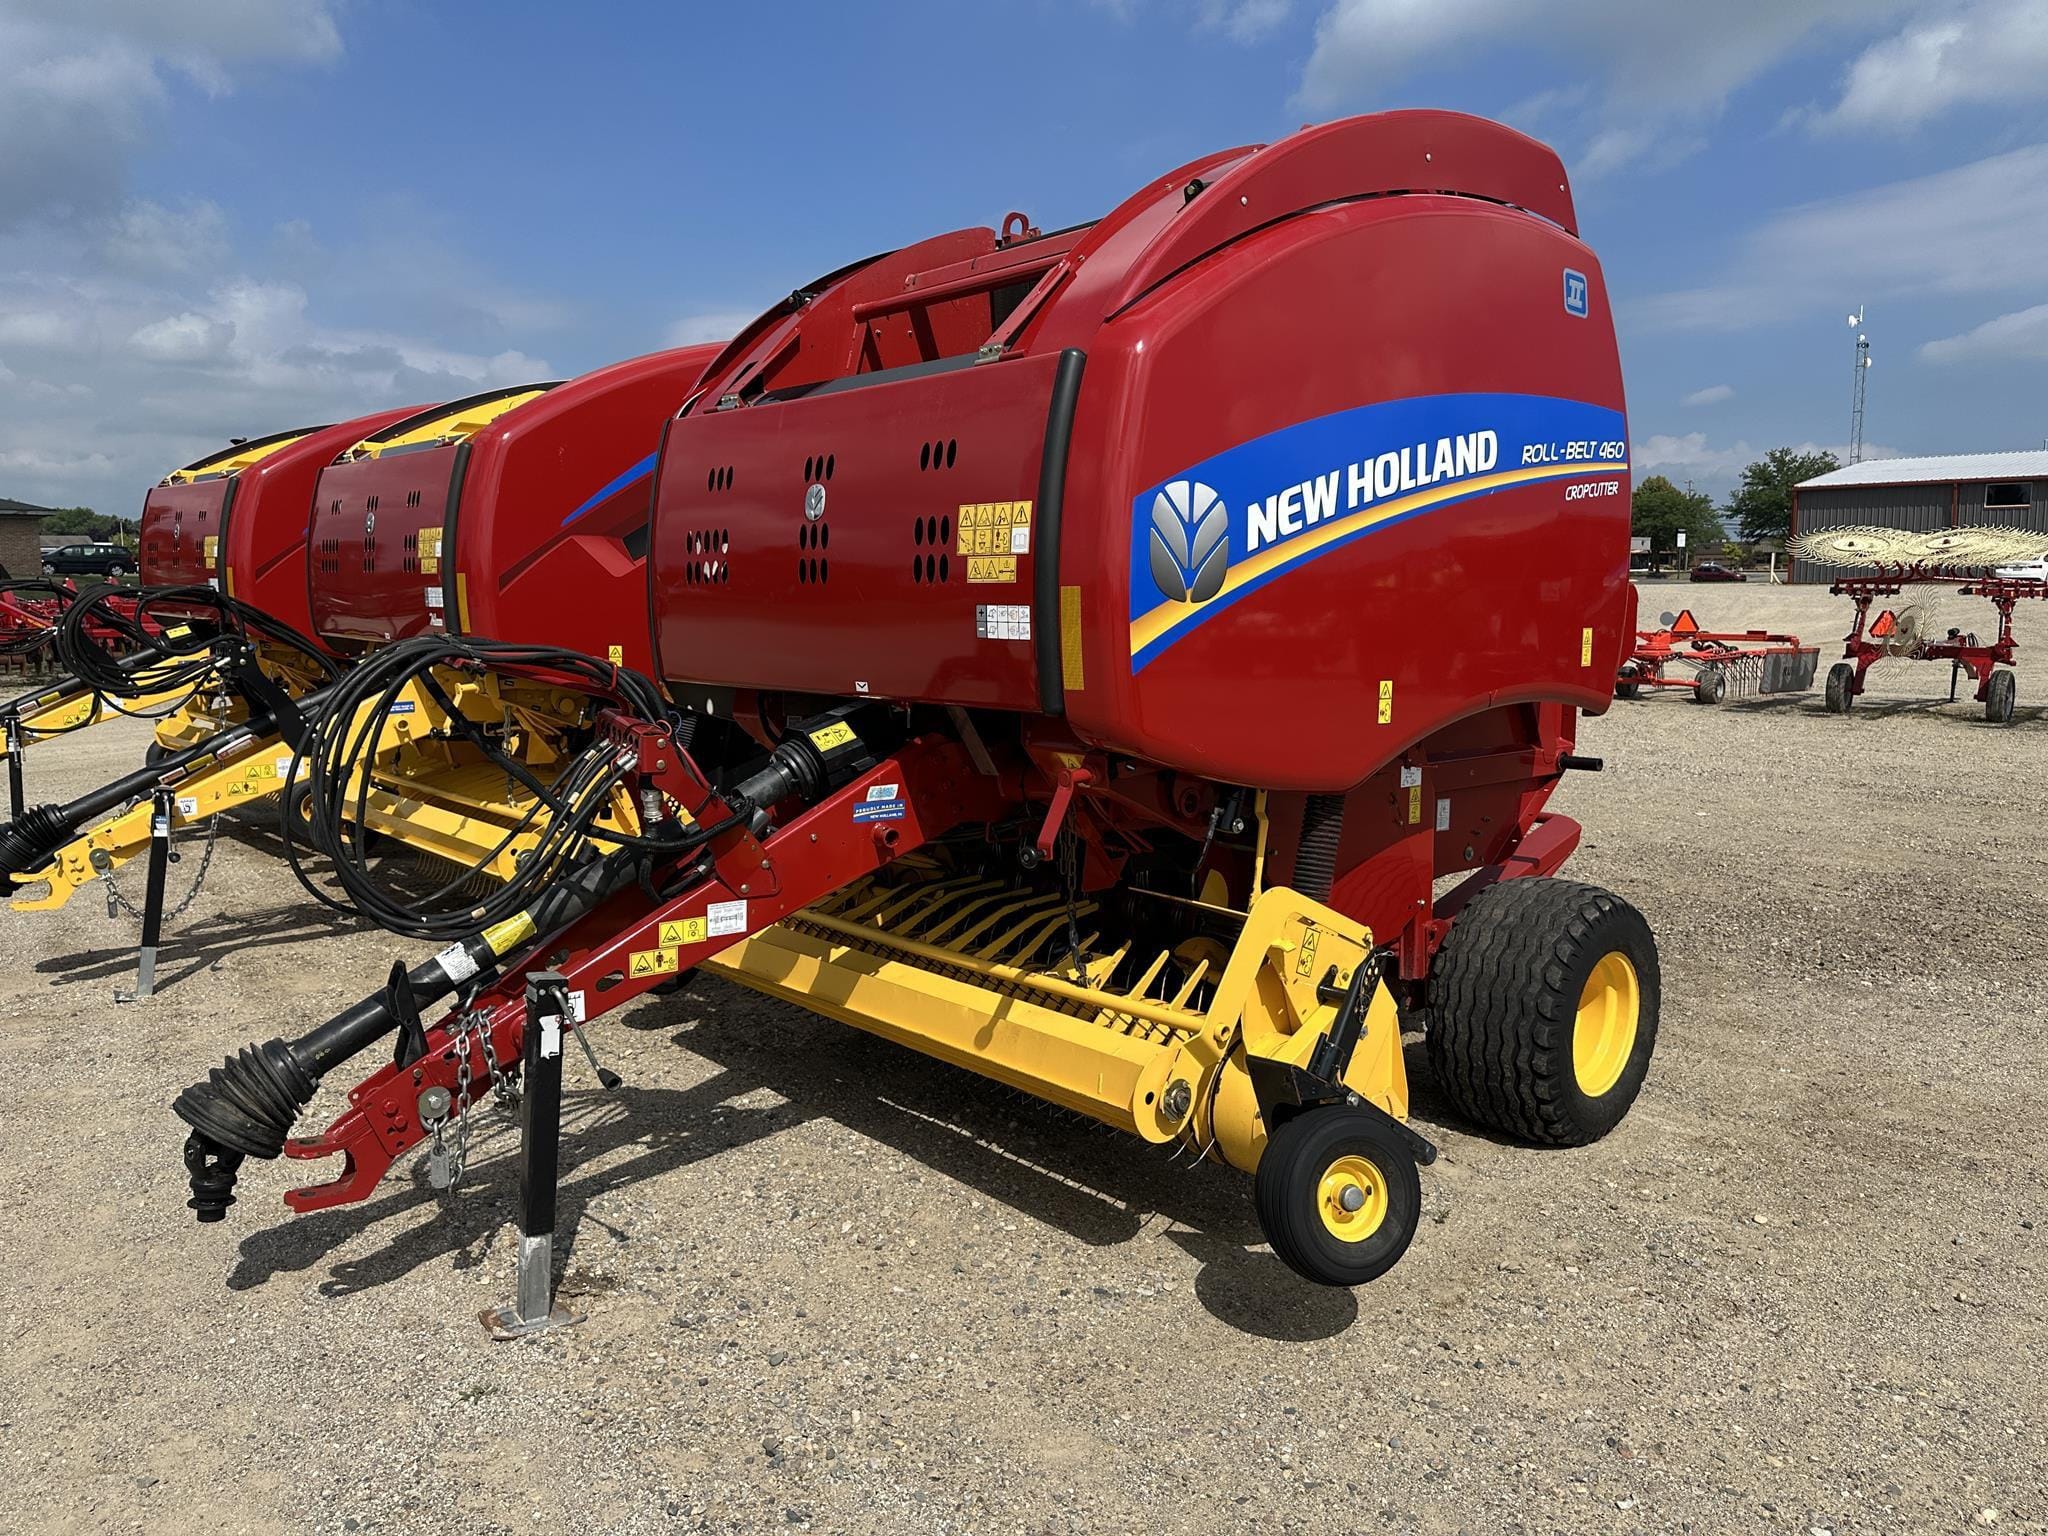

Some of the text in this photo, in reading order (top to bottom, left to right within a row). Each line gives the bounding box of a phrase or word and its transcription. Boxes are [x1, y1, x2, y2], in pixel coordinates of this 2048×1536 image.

[1521, 441, 1625, 464] ROLL-BELT 460
[1247, 429, 1498, 552] NEW HOLLAND
[1565, 481, 1619, 501] CROPCUTTER
